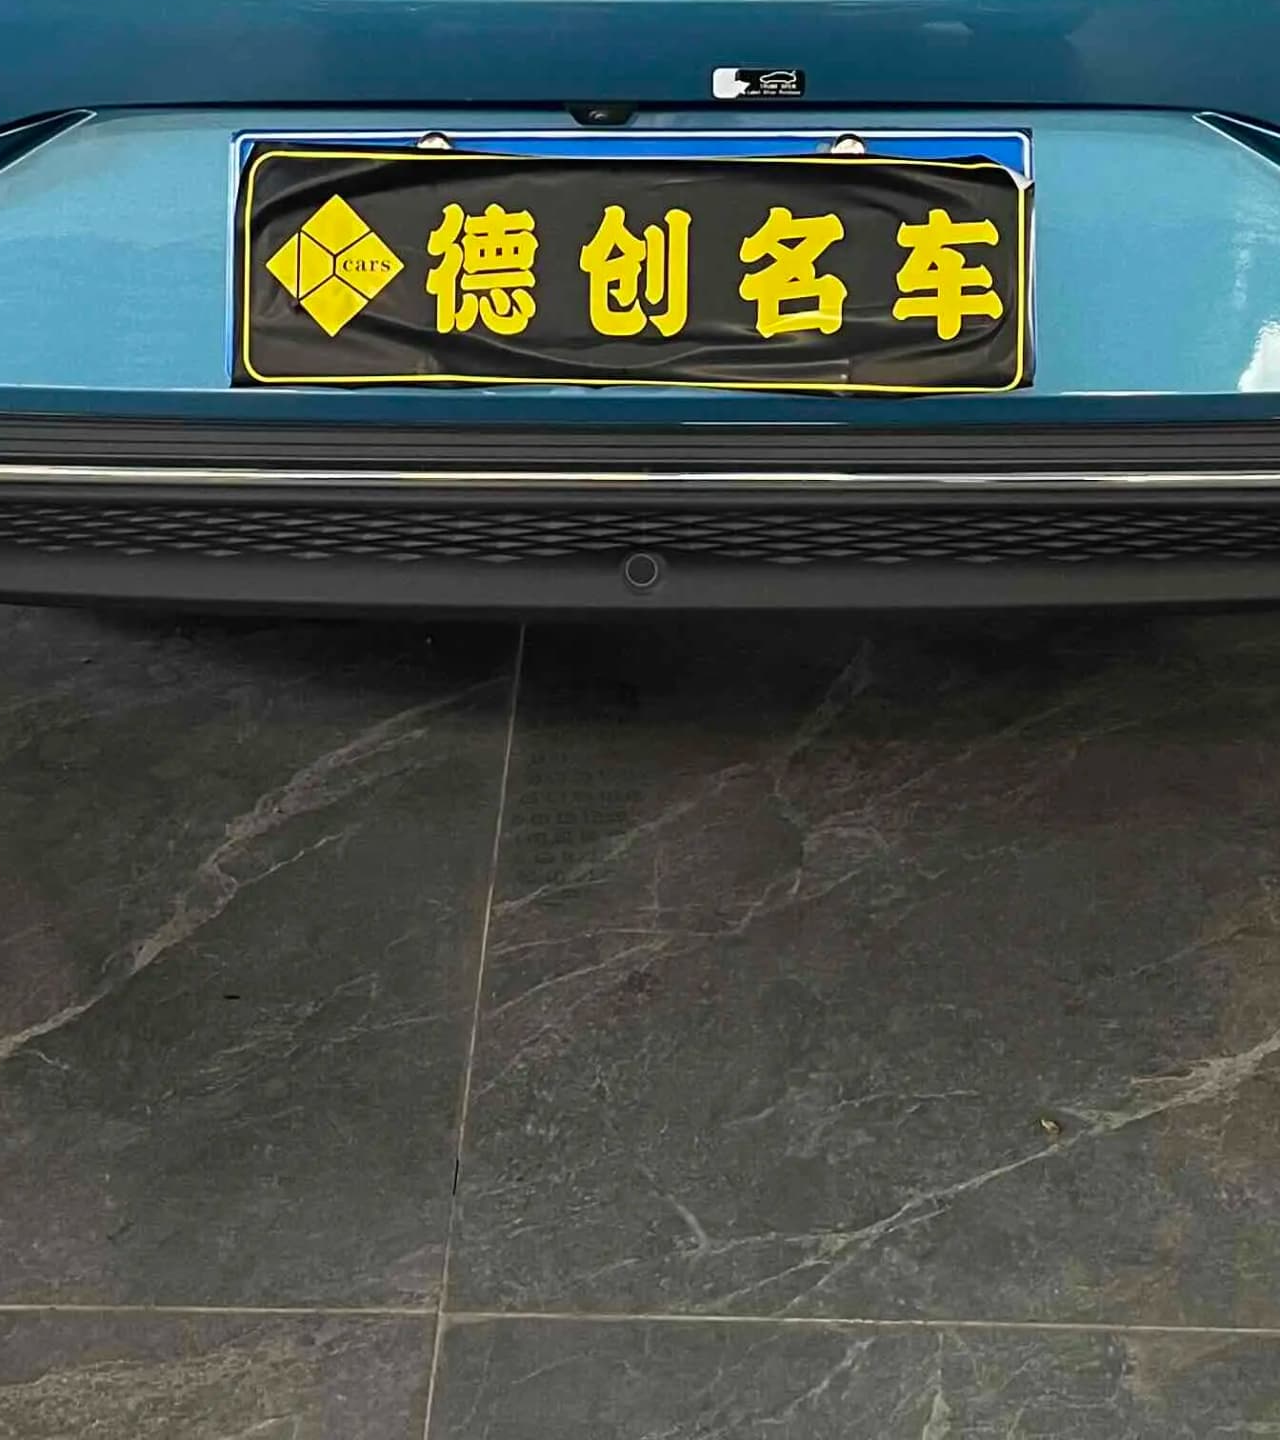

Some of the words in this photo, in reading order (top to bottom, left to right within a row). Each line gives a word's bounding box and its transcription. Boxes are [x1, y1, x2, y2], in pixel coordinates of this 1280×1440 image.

[342, 257, 391, 273] cars
[427, 203, 1004, 340] 德创名车
